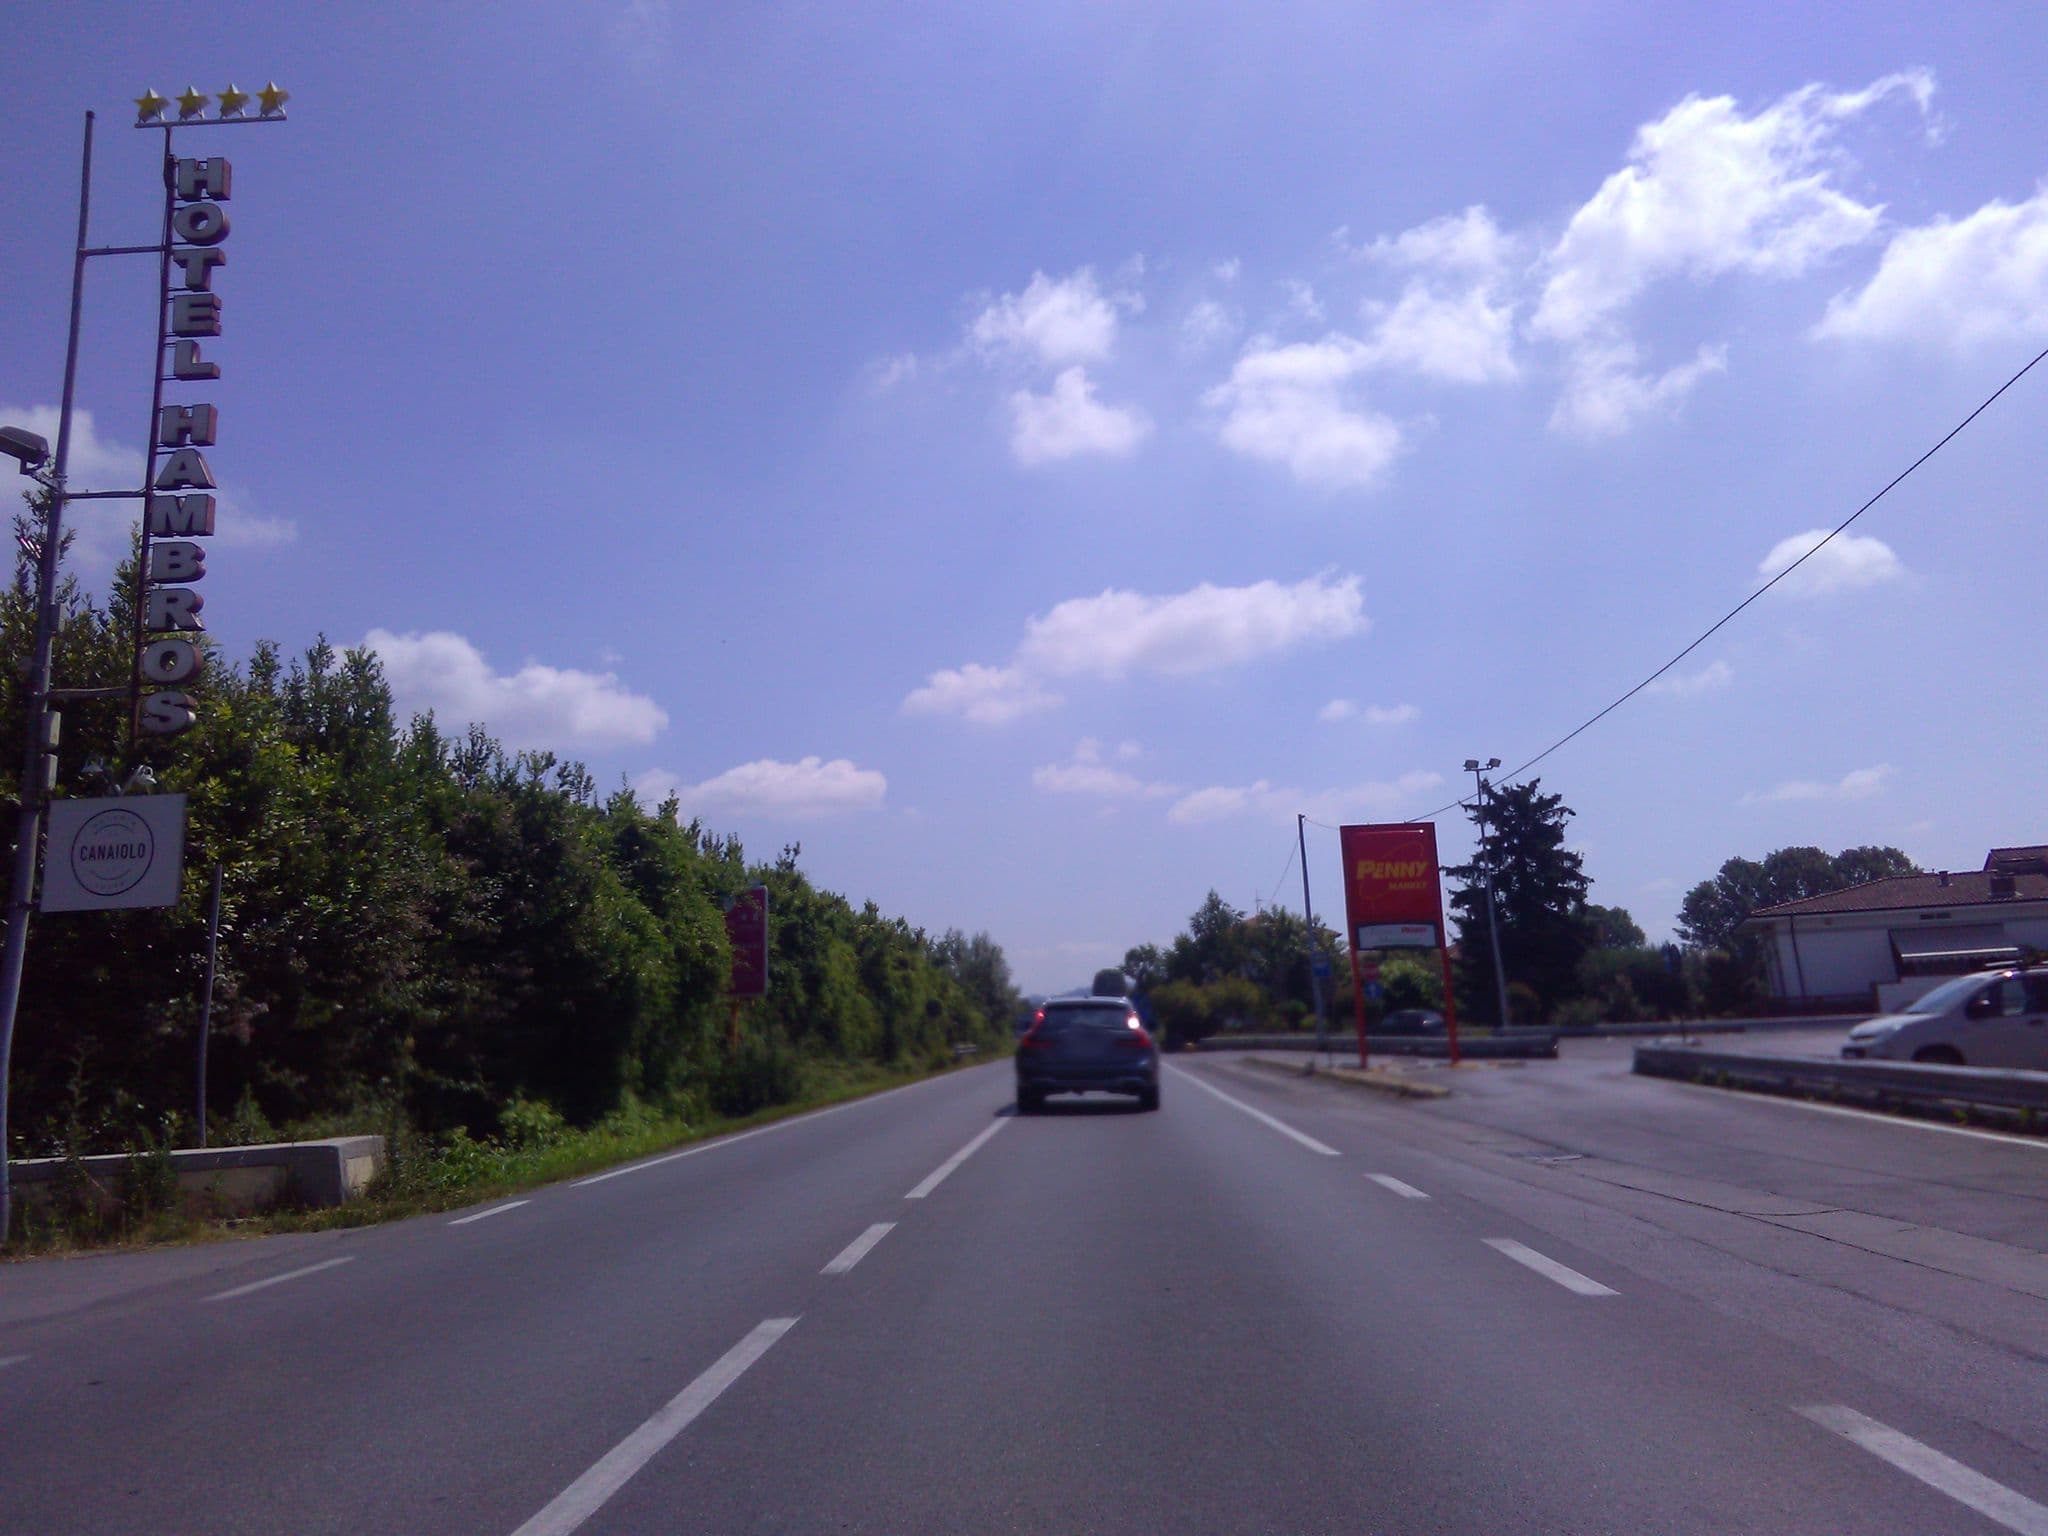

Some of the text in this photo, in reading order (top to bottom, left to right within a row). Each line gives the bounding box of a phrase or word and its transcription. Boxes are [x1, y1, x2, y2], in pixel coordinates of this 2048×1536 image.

[141, 157, 231, 734] HOTEL HAMBROS
[80, 842, 146, 861] CANAIOLO
[1357, 860, 1427, 880] PENNY
